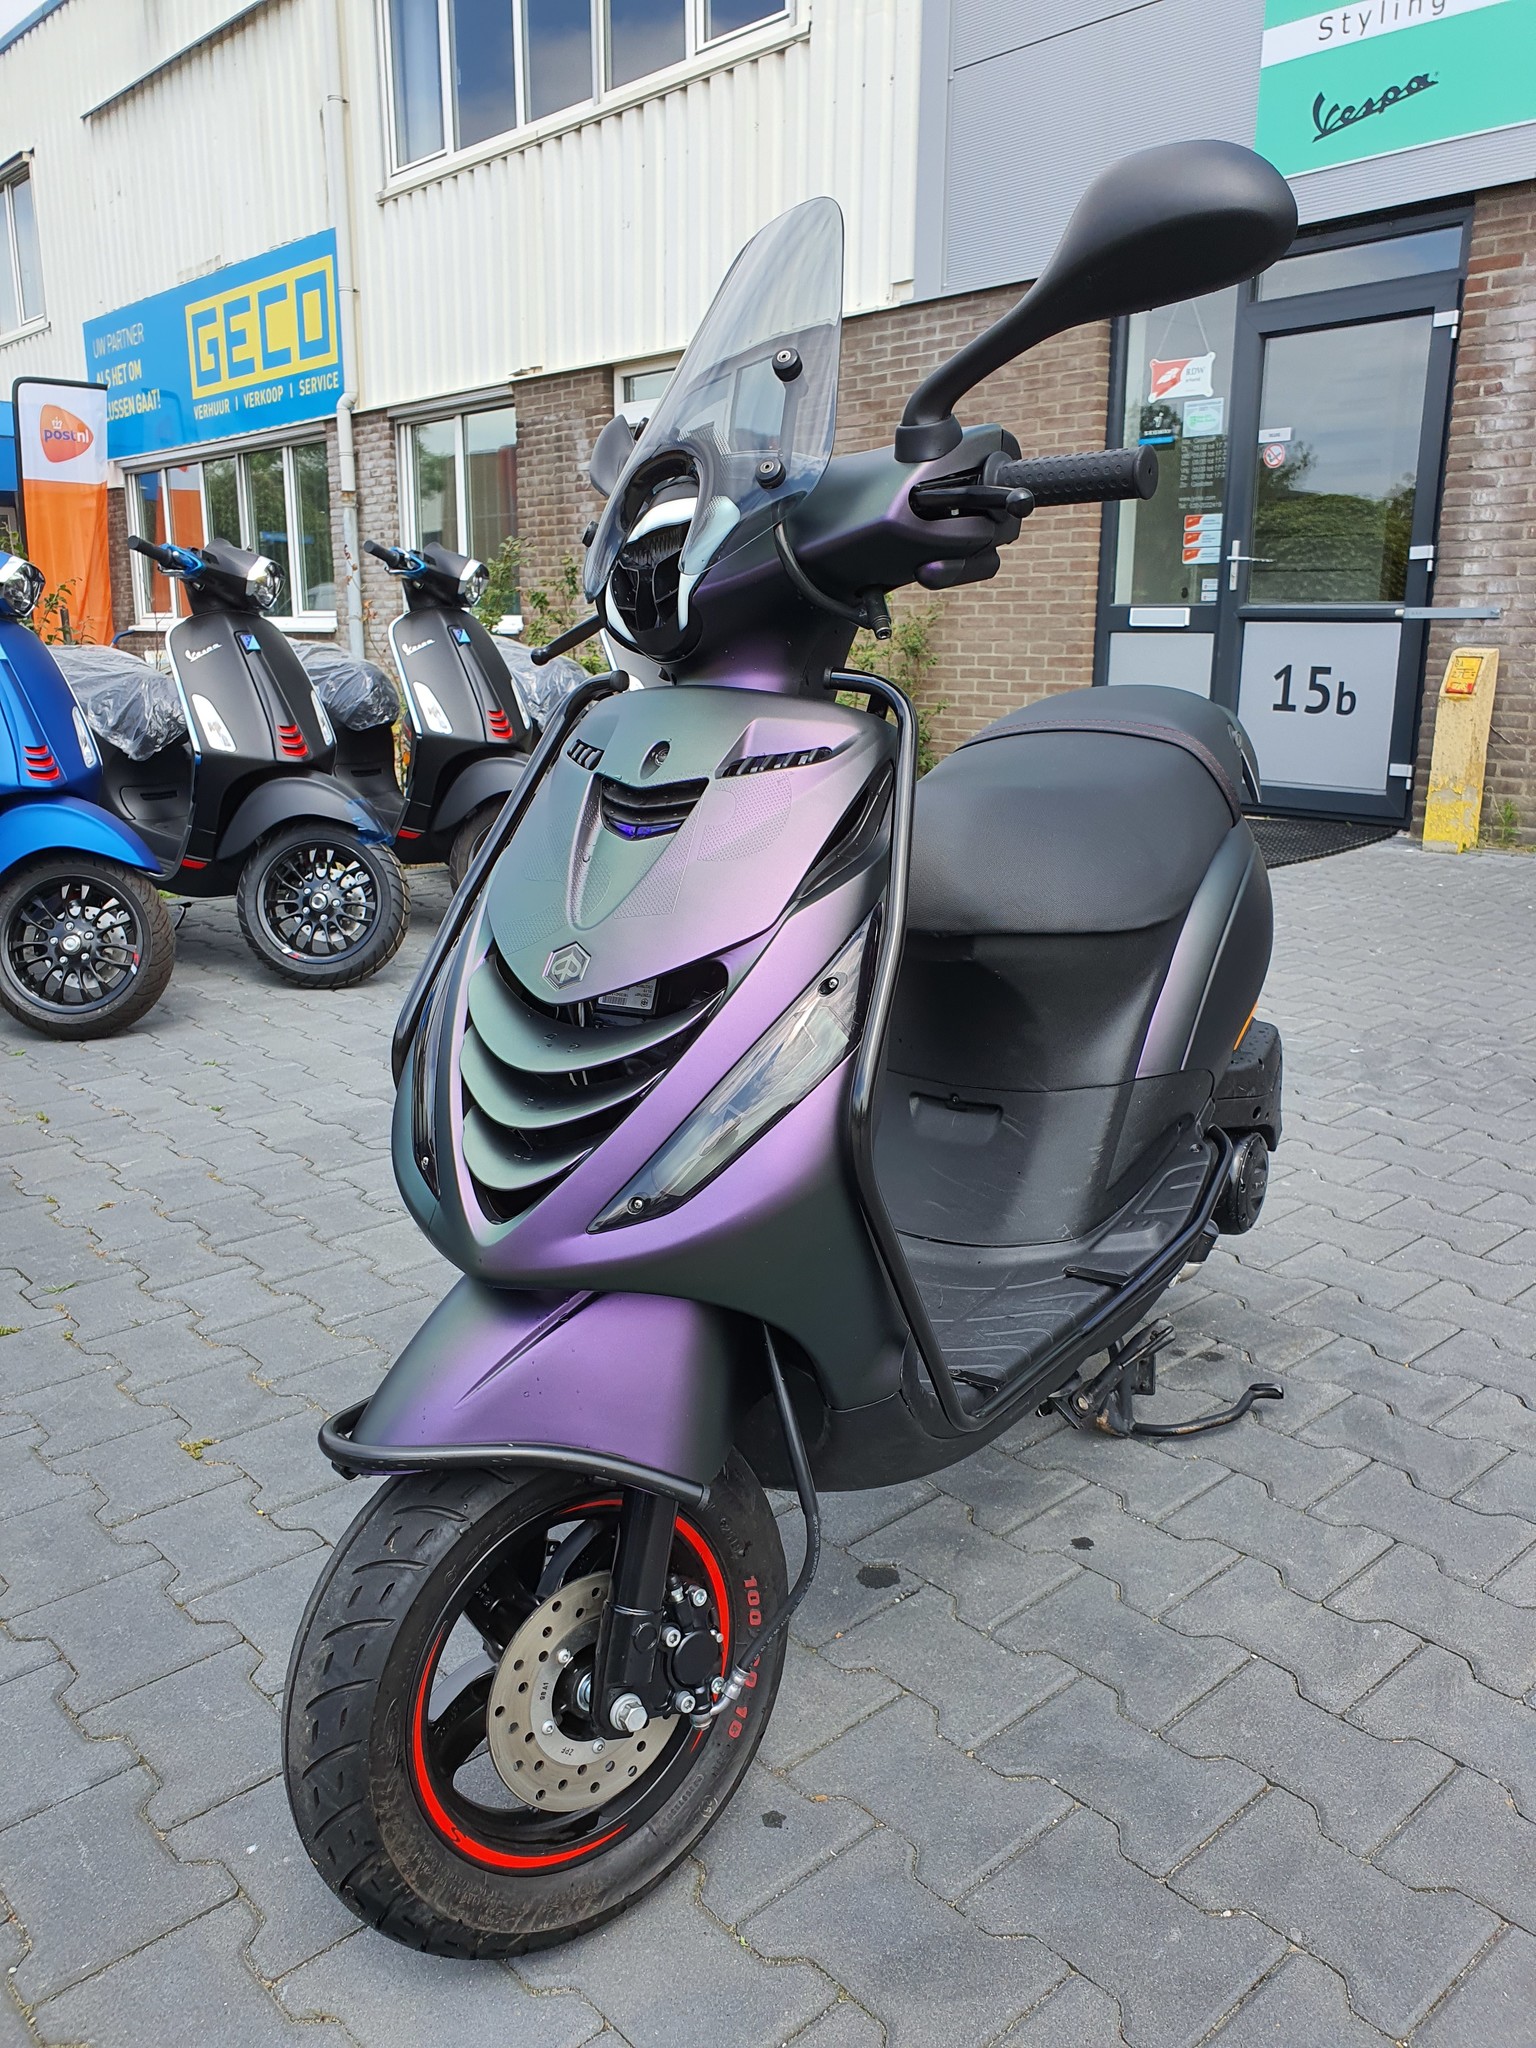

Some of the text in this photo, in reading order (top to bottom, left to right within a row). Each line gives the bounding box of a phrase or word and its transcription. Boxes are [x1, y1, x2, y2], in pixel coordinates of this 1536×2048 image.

[1318, 0, 1446, 41] Styling
[1312, 73, 1439, 143] Vespa
[92, 322, 145, 359] UW PARTNER
[190, 269, 332, 389] GECO
[111, 362, 127, 387] HET
[128, 358, 142, 382] OM
[136, 388, 161, 415] GAAT!
[193, 398, 230, 421] VERHUUR
[243, 385, 284, 409] VERKOOP
[299, 371, 339, 397] SERVICE
[1272, 664, 1357, 716] 15b
